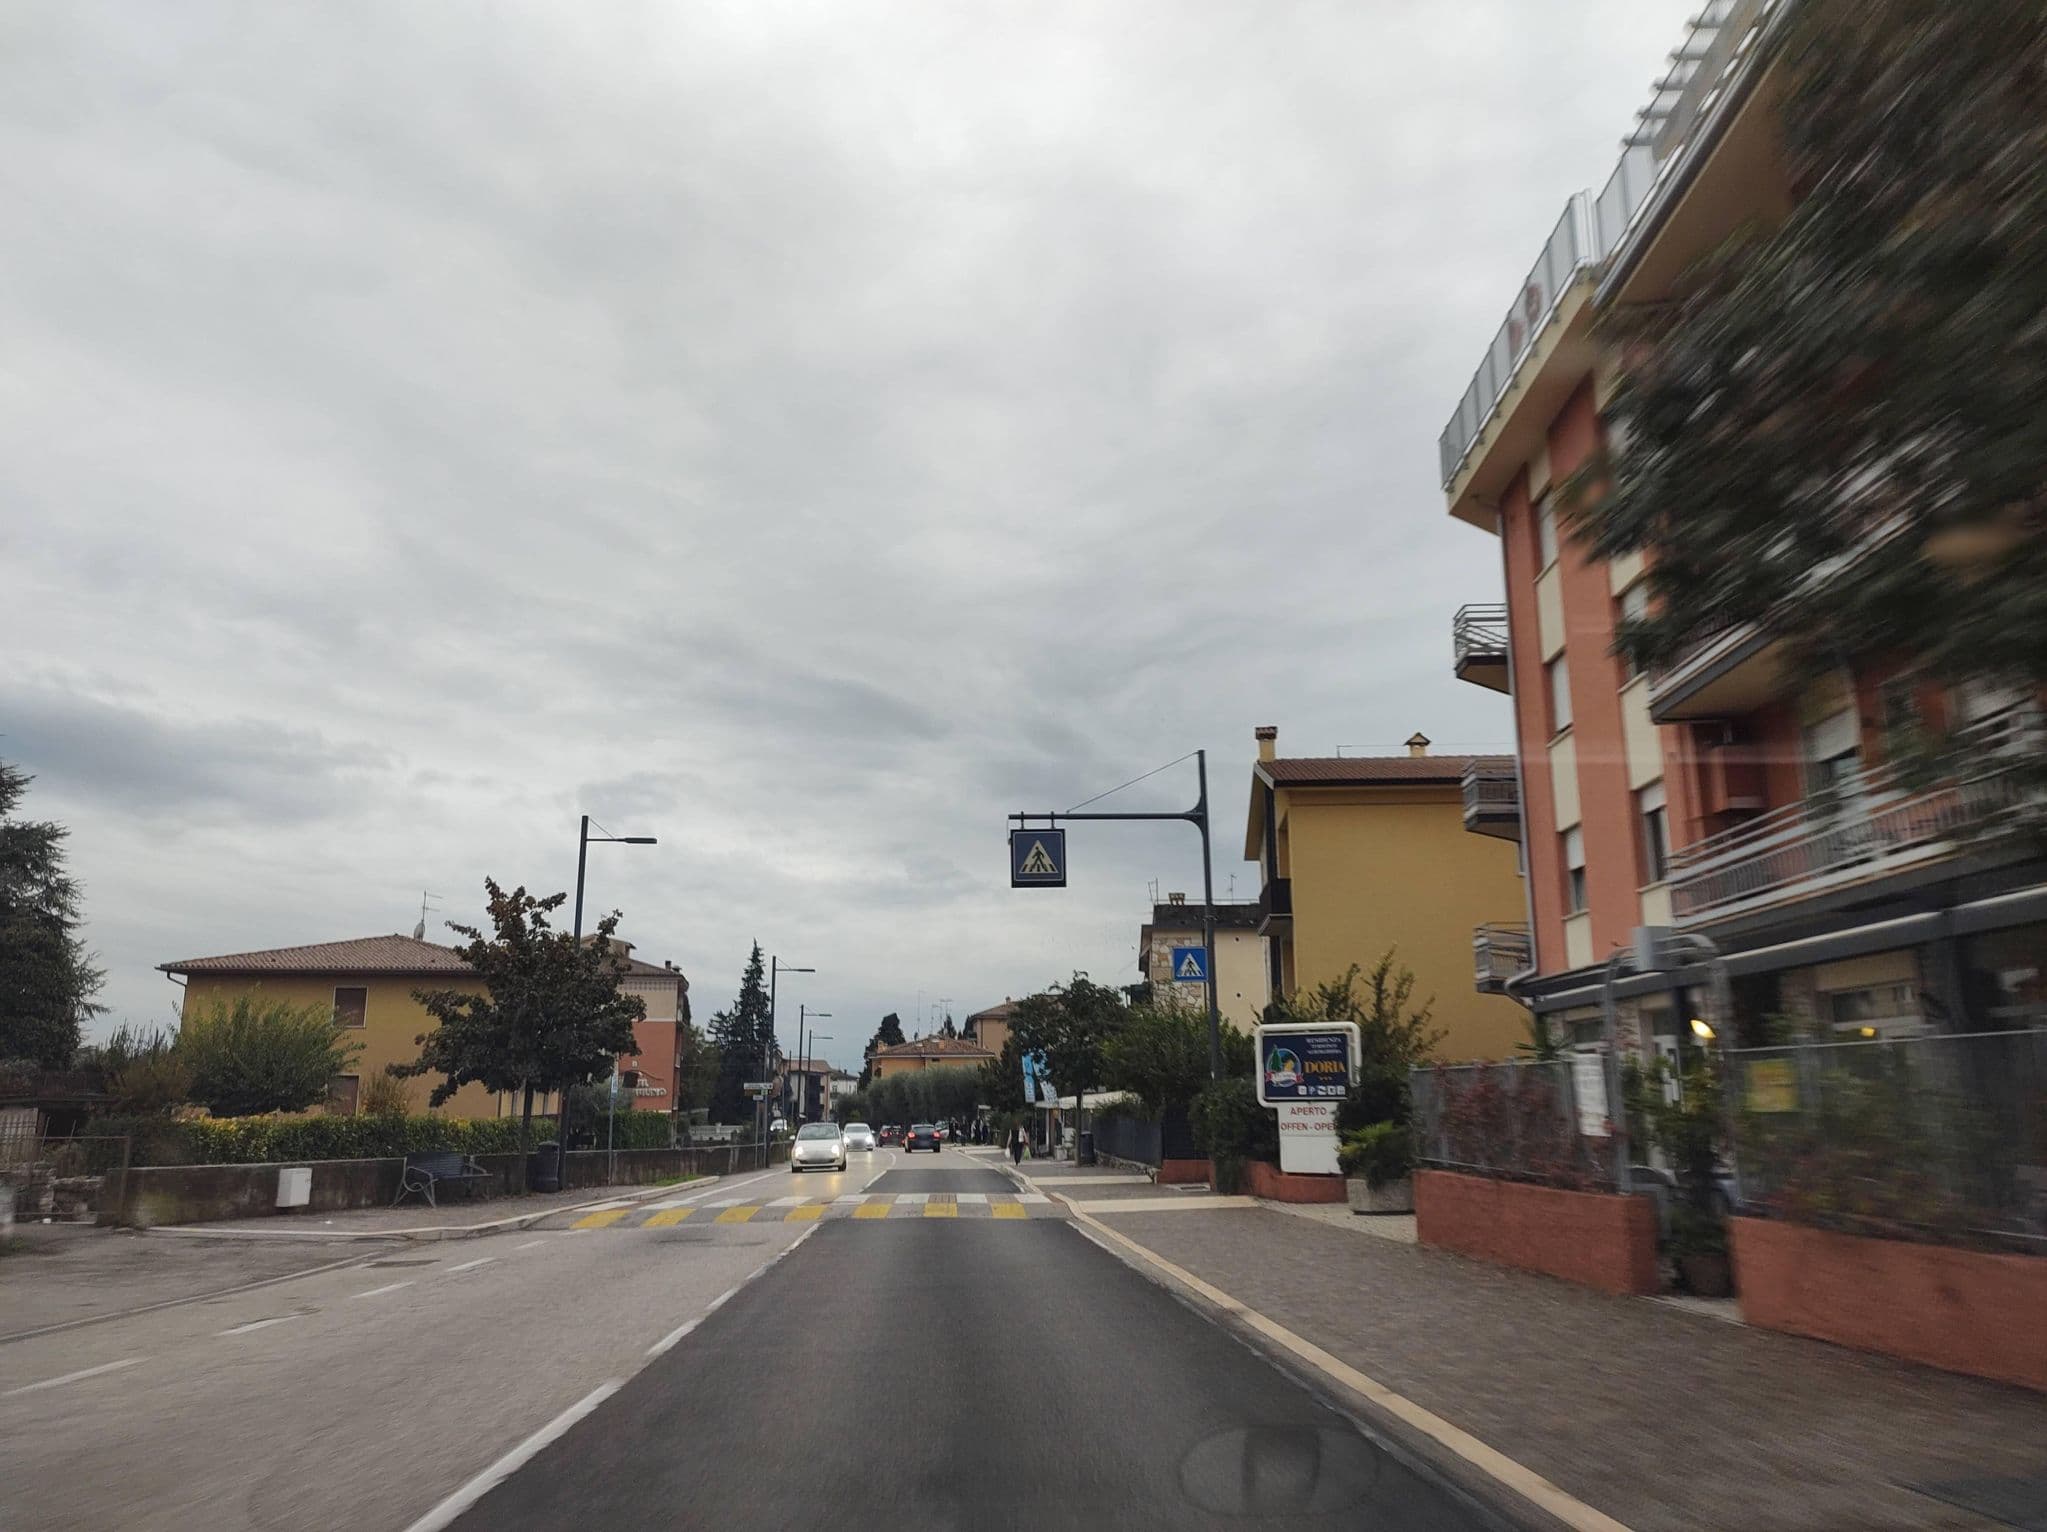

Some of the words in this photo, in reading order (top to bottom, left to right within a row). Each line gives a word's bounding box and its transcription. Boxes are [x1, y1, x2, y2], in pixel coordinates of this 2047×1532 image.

[1304, 1060, 1346, 1073] DORIA
[1290, 1107, 1327, 1115] APERTO
[1280, 1122, 1308, 1130] OFFEN
